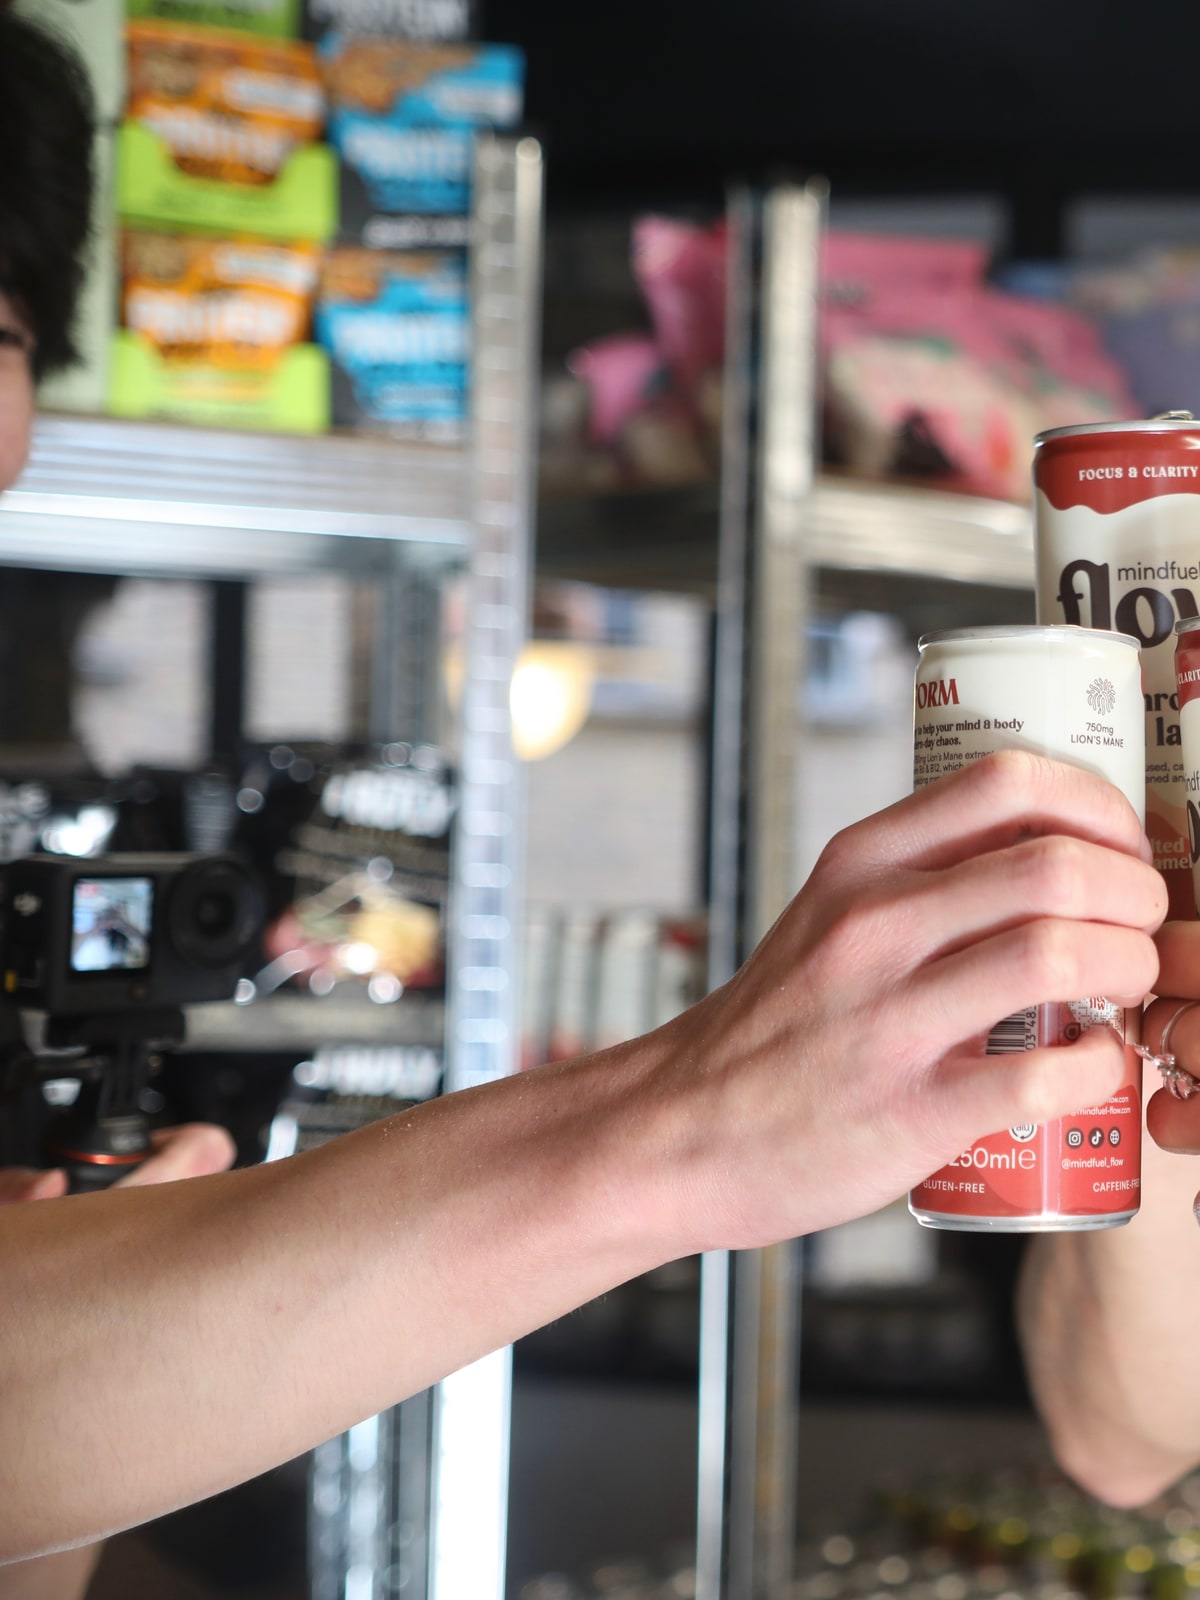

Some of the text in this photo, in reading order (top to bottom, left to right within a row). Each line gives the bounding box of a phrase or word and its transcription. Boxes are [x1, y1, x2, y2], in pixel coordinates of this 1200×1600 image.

[1079, 466, 1199, 481] FOCUS & CLARITY
[935, 724, 954, 736] your
[956, 720, 981, 732] mind
[983, 720, 991, 730] &
[994, 719, 1024, 732] body
[1086, 722, 1114, 736] 750mg
[936, 736, 961, 747] chaos.
[1071, 735, 1124, 748] LION'S MANE
[943, 752, 963, 761] Mane
[1062, 1158, 1123, 1169] @mindfuel_flow
[923, 1179, 985, 1193] GLUTEN-FREE
